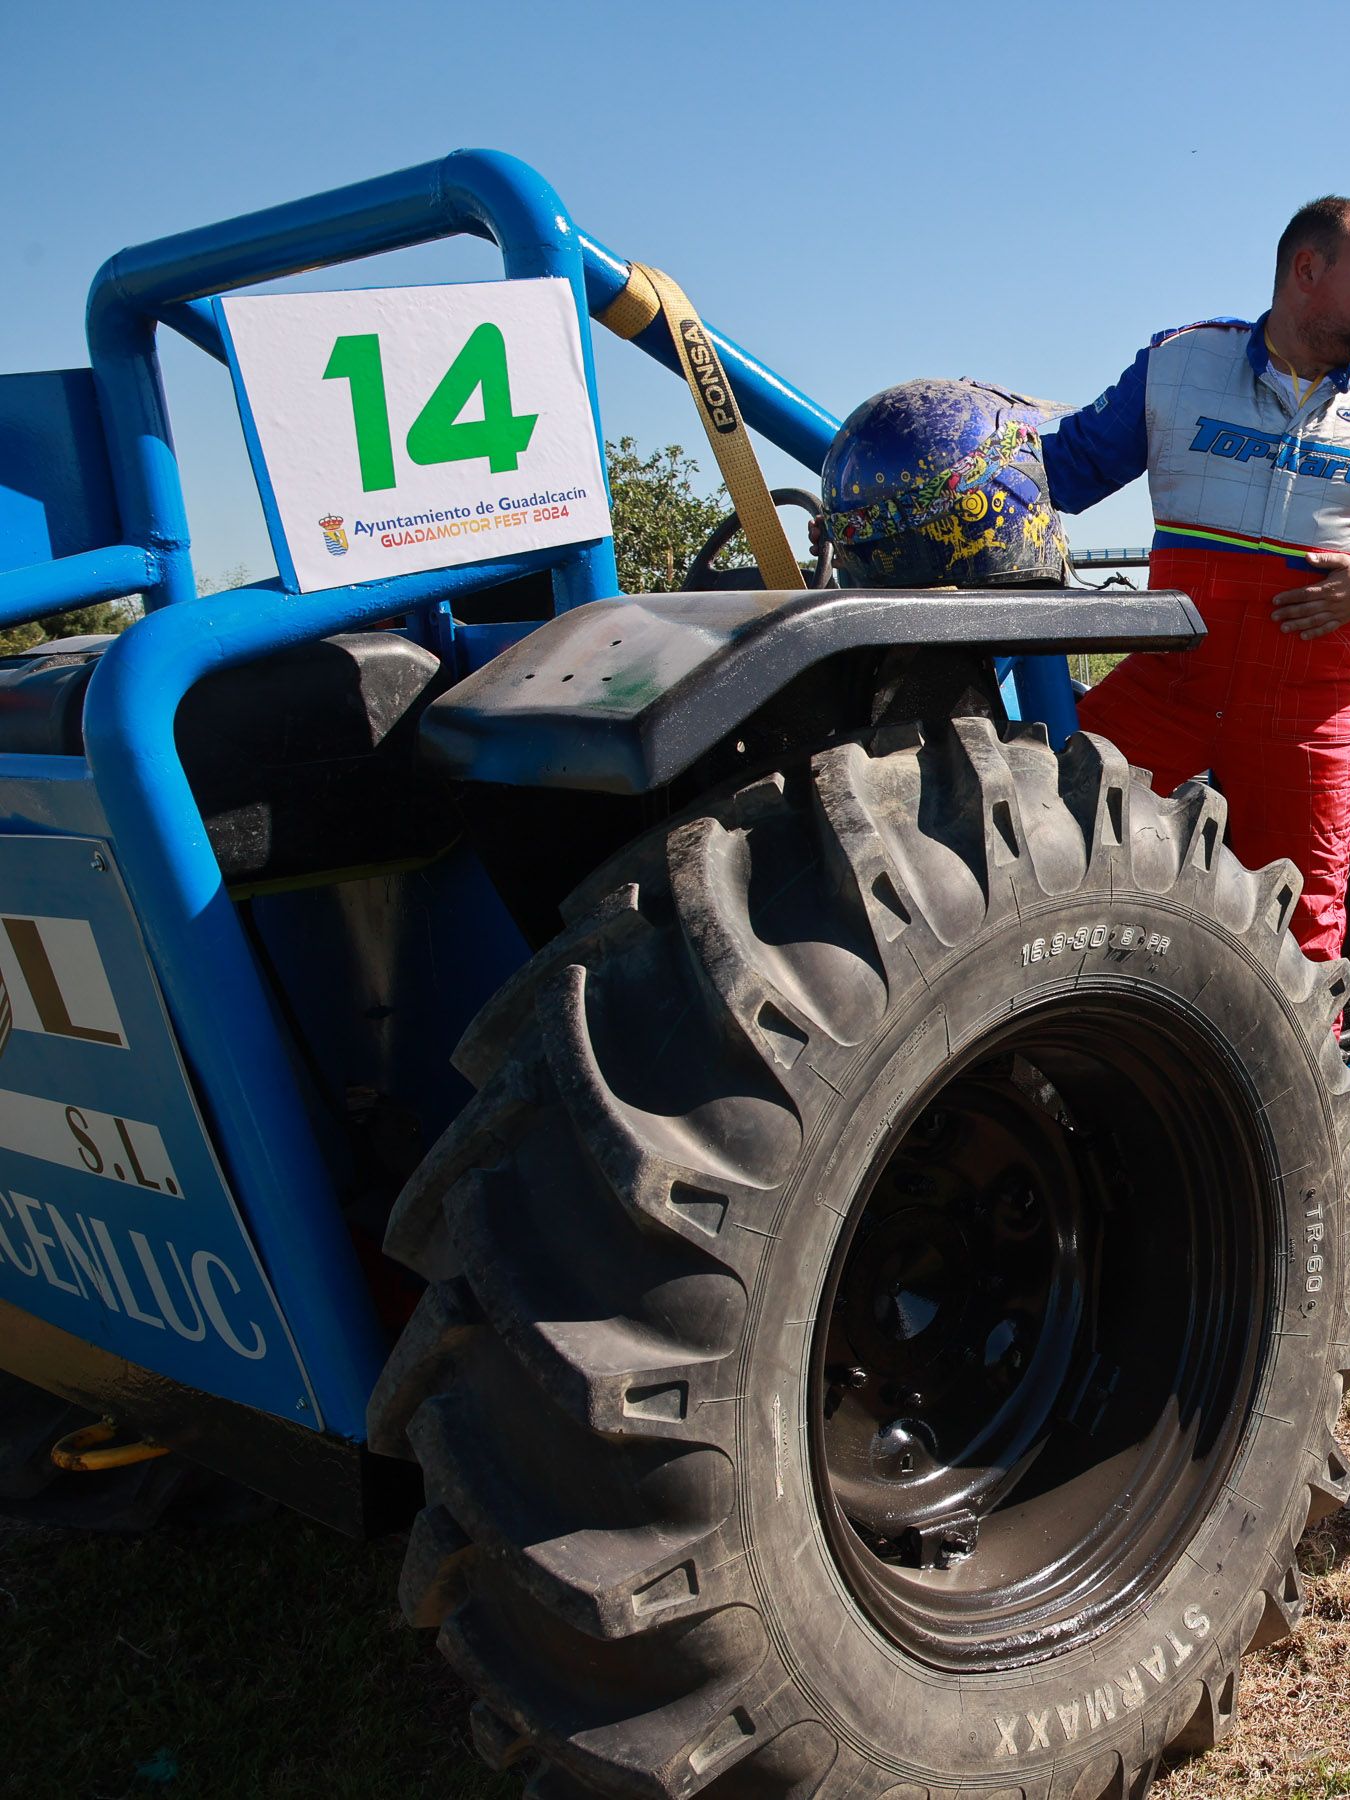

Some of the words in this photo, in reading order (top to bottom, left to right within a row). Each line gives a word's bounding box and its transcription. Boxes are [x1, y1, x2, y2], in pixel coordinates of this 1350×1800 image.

[322, 322, 538, 492] 14
[683, 323, 735, 428] PONSA
[354, 507, 471, 538] Ayuntamiento
[476, 502, 495, 516] de
[499, 487, 587, 511] Guadalcacín
[381, 518, 491, 548] GUADAMOTOR
[494, 511, 528, 529] FEST
[533, 505, 569, 522] 2024
[1021, 924, 1108, 967] 16.9-30
[65, 1105, 178, 1196] S.L.
[0, 1189, 267, 1361] CENLUC
[1305, 1203, 1324, 1293] TR-60
[993, 1602, 1211, 1757] STARMAXX
